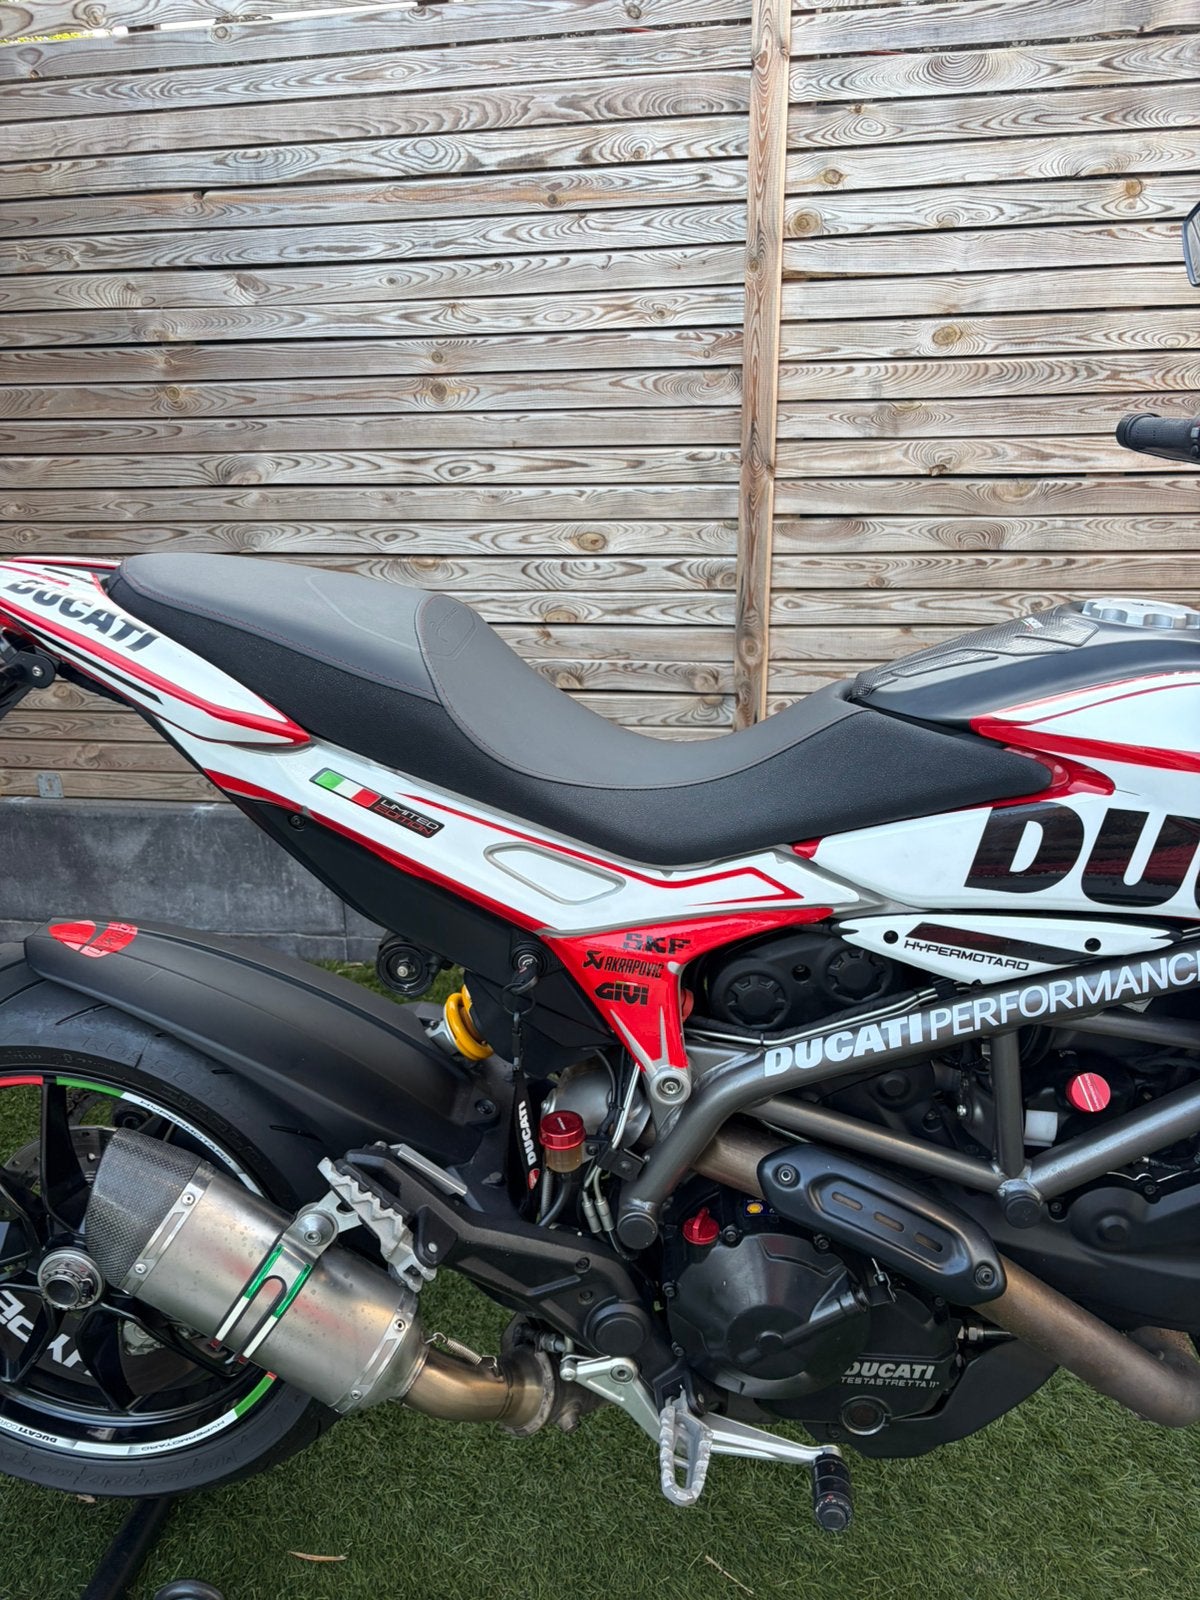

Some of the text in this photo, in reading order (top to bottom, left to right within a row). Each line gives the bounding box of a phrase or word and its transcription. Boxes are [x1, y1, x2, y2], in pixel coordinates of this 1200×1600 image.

[4, 578, 160, 652] DUCATI
[373, 804, 434, 835] EDITION
[380, 799, 440, 830] LIMITED
[963, 801, 1200, 907] DU
[622, 932, 691, 955] SKF
[904, 940, 1030, 971] HYPERMOTARD
[594, 981, 649, 1006] GIVI
[764, 950, 1200, 1077] DUCATI PERFORMANC
[518, 1100, 537, 1166] DUCATI
[841, 1376, 927, 1388] TESTASTRETTA
[844, 1361, 935, 1380] DUCATI
[18, 1427, 58, 1443] DUCATI
